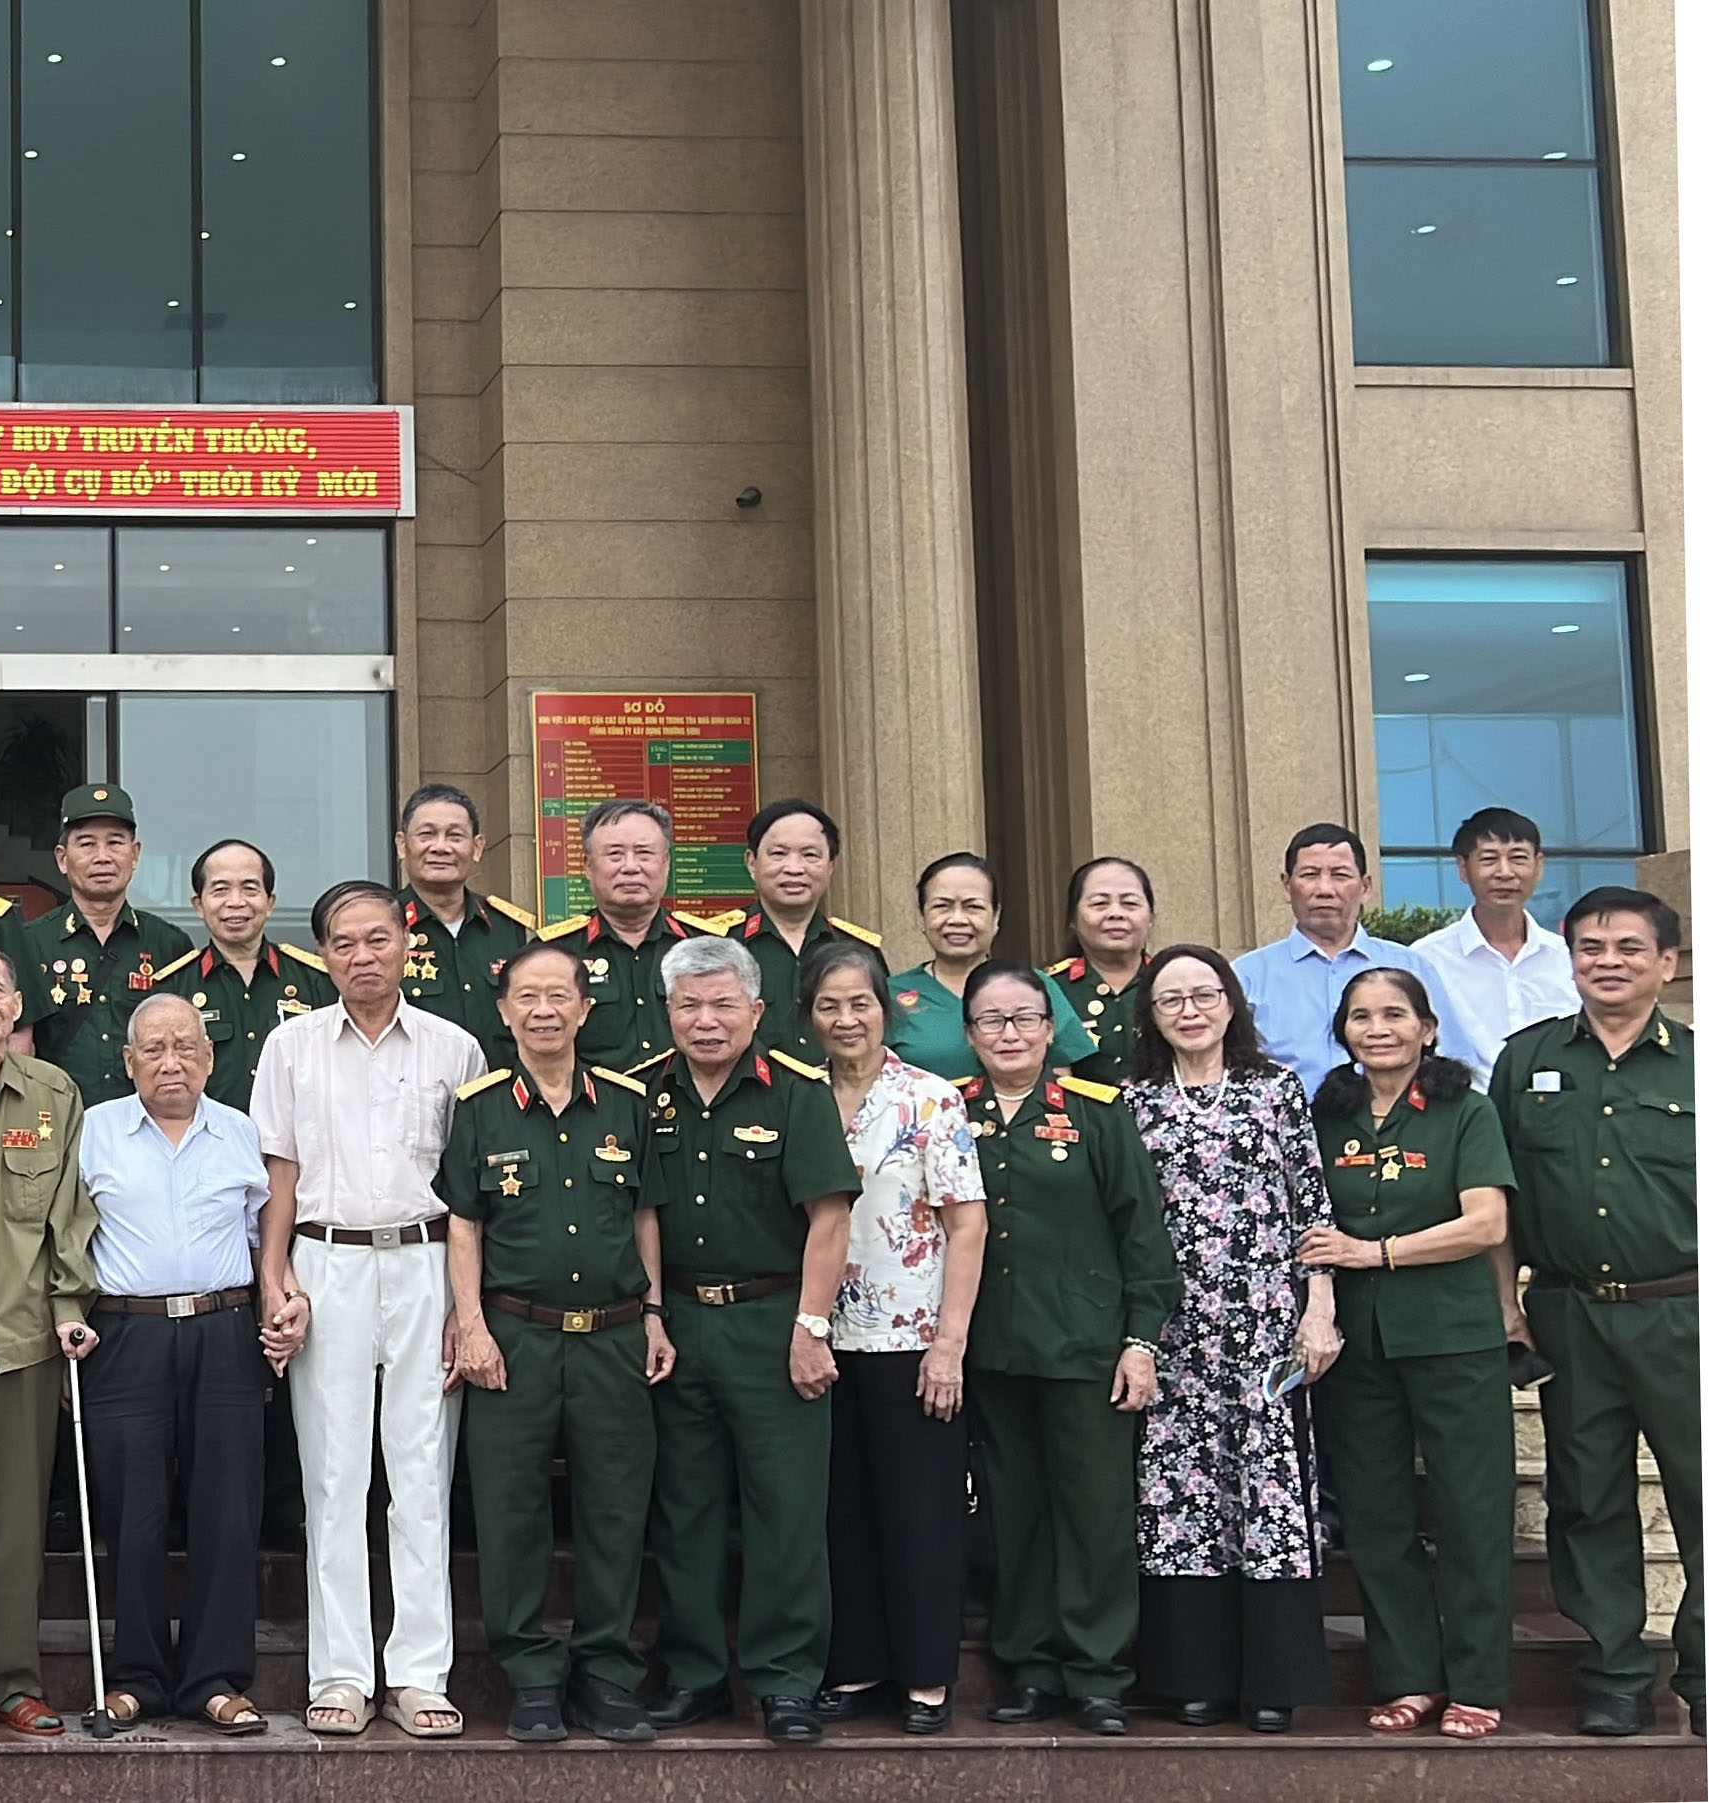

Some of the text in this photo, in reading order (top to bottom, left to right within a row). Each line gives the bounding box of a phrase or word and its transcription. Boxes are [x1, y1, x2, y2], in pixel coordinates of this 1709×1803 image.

[11, 426, 72, 452] HUY
[202, 416, 318, 460] THỐNG,
[0, 463, 57, 501] ĐỘI
[63, 470, 103, 501] CỤ
[624, 702, 642, 713] SƠ
